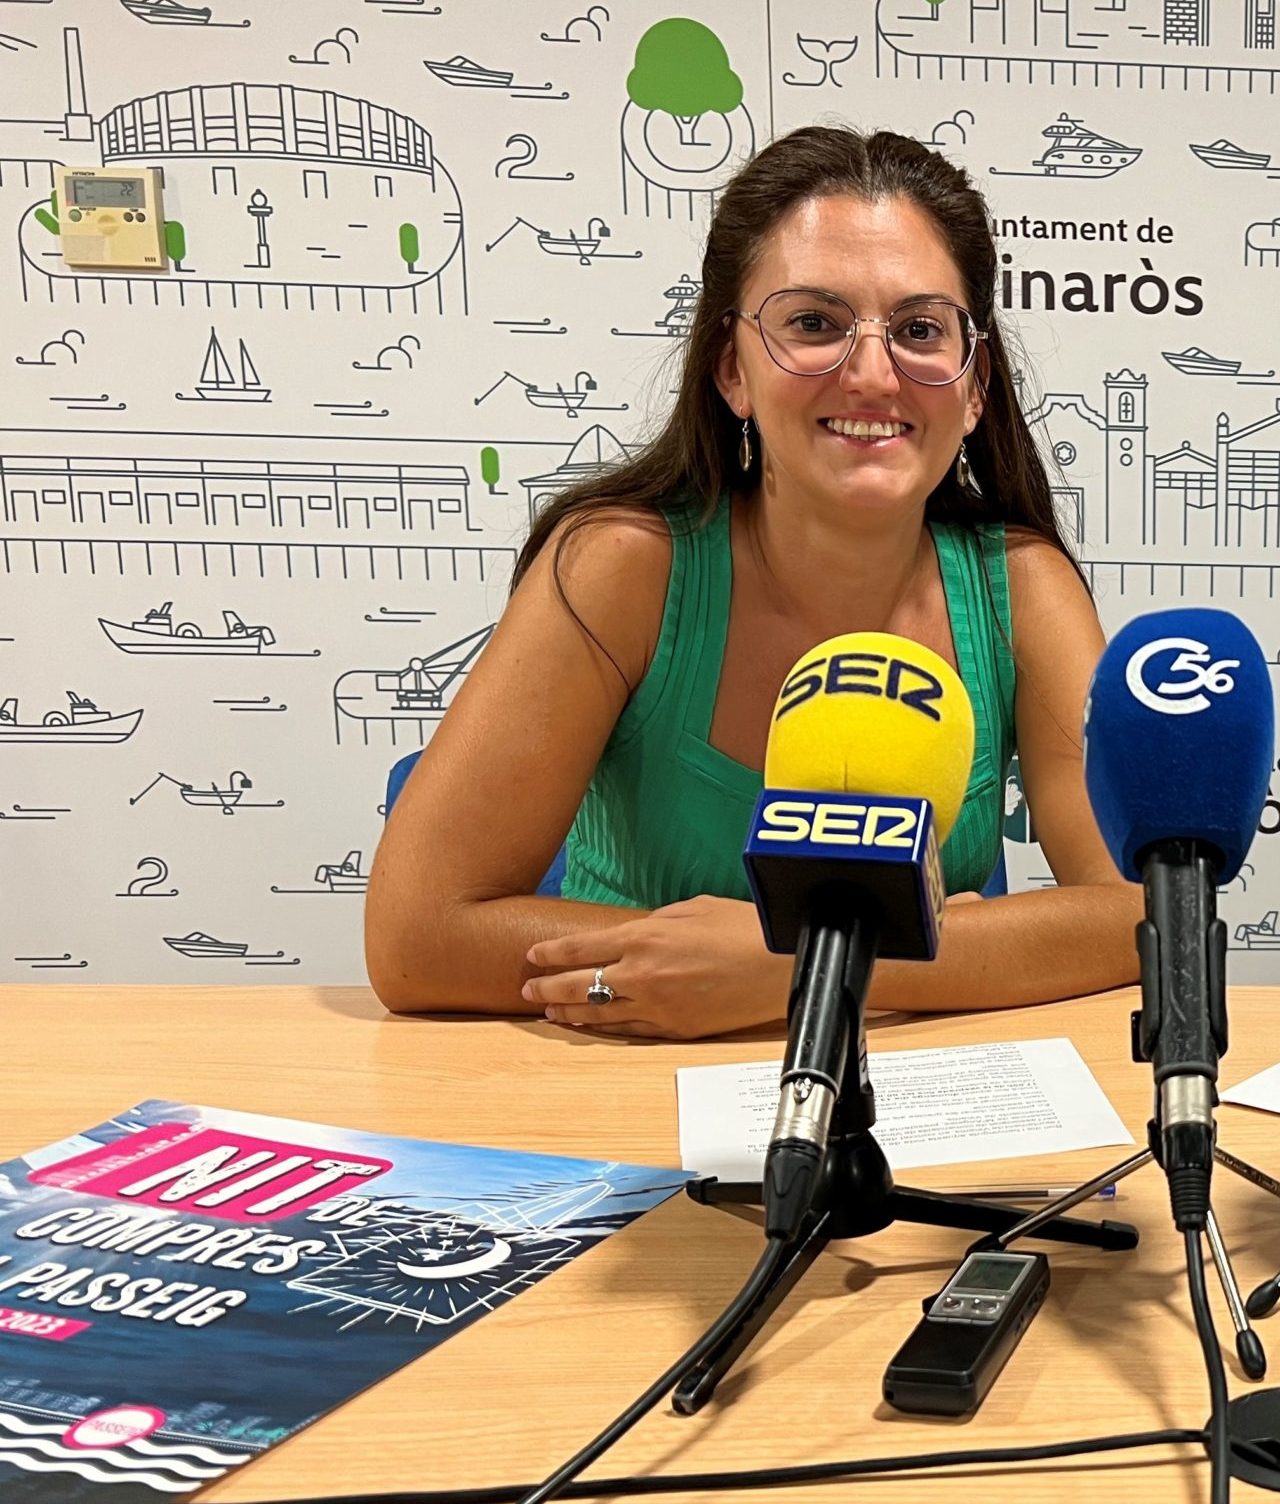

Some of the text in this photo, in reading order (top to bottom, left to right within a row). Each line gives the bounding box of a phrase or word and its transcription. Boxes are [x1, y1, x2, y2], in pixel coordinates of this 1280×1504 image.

[992, 216, 1173, 243] ntament de
[1001, 253, 1203, 316] inaròs
[775, 653, 944, 721] SER
[757, 801, 917, 847] SER
[119, 1145, 405, 1228] NIT DE
[0, 1262, 247, 1327] PASSEIG
[8, 1311, 67, 1334] 2023
